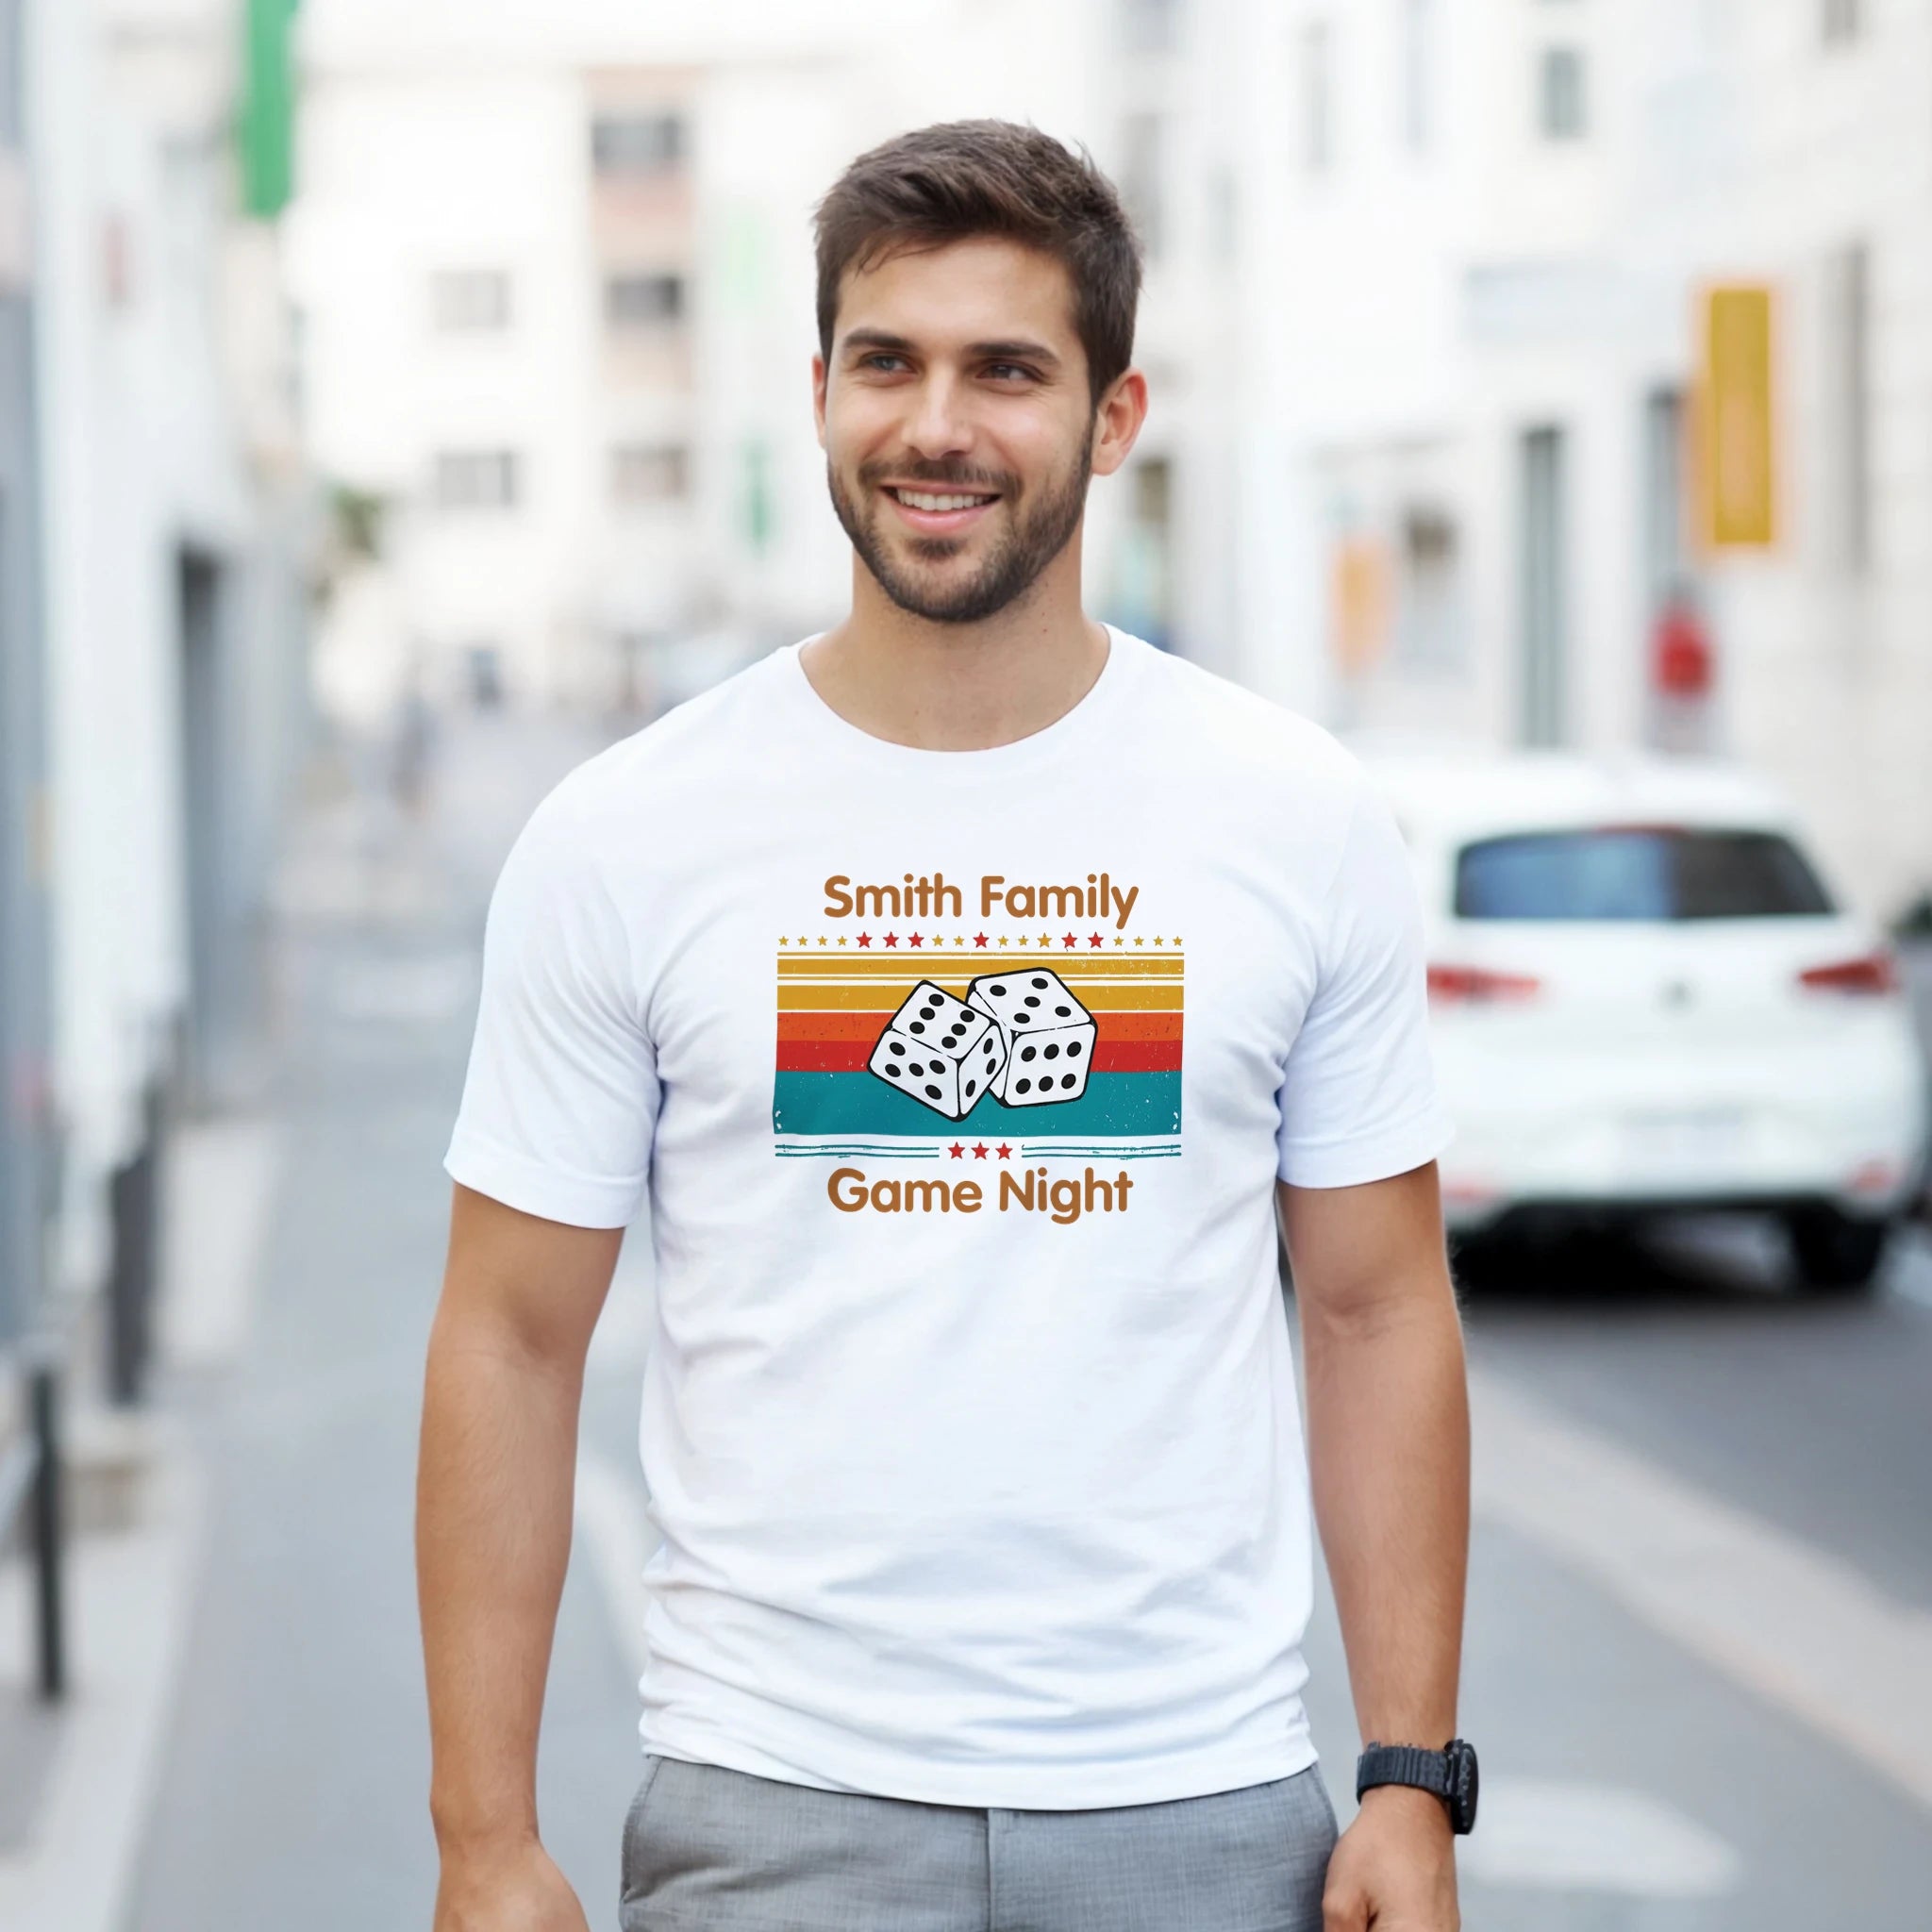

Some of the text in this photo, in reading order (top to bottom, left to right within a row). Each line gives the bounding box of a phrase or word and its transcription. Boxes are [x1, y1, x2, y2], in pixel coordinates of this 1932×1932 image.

[824, 872, 1140, 930] Smith Family
[827, 1167, 1134, 1225] Game Night
